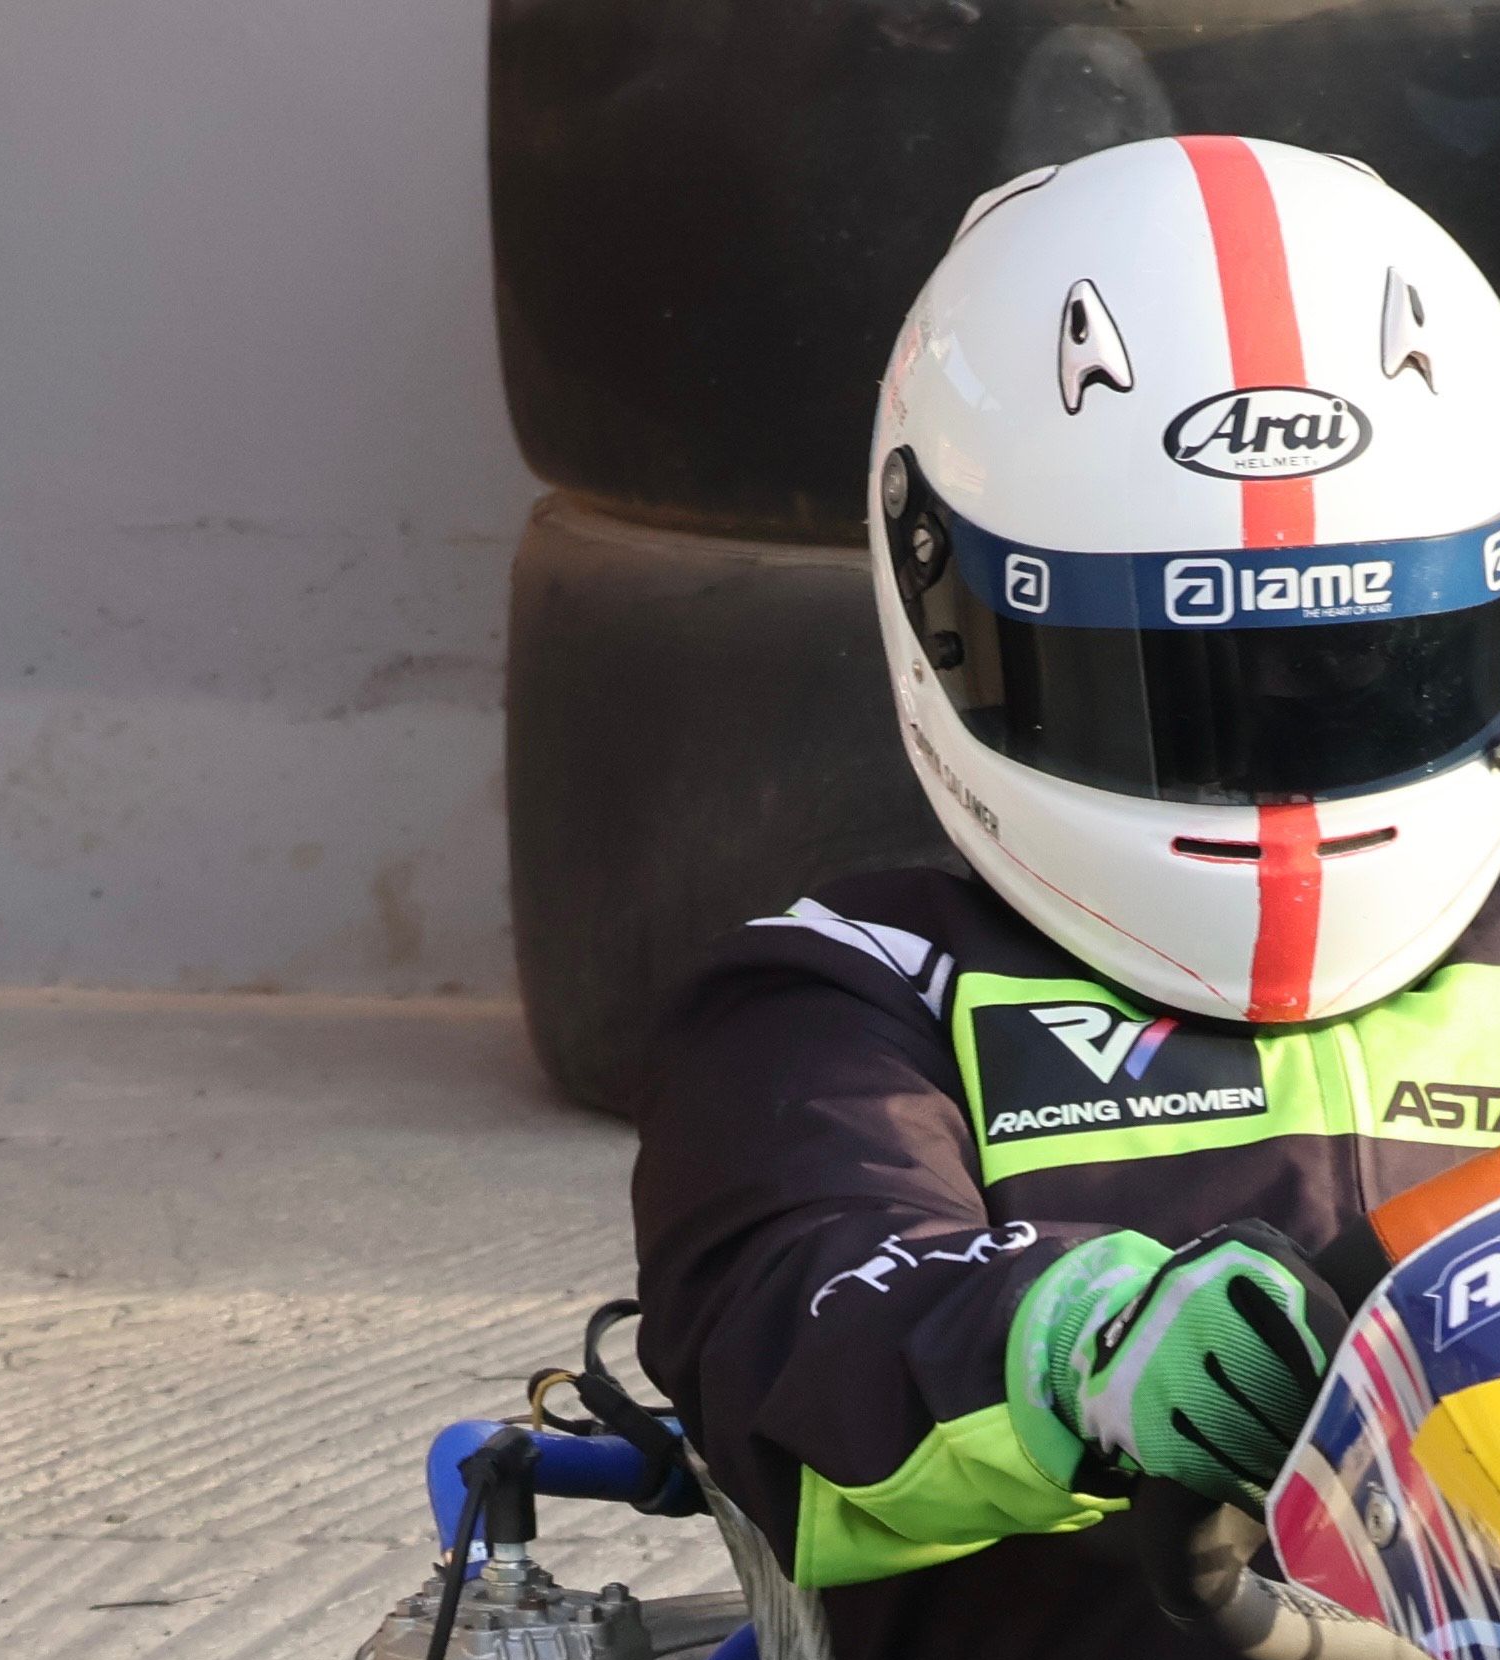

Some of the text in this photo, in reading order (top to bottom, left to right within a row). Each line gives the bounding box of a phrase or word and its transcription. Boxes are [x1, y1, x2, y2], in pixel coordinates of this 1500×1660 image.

[1177, 397, 1348, 459] Arai
[1233, 455, 1312, 470] HELMET
[988, 1087, 1265, 1136] RACING WOMEN
